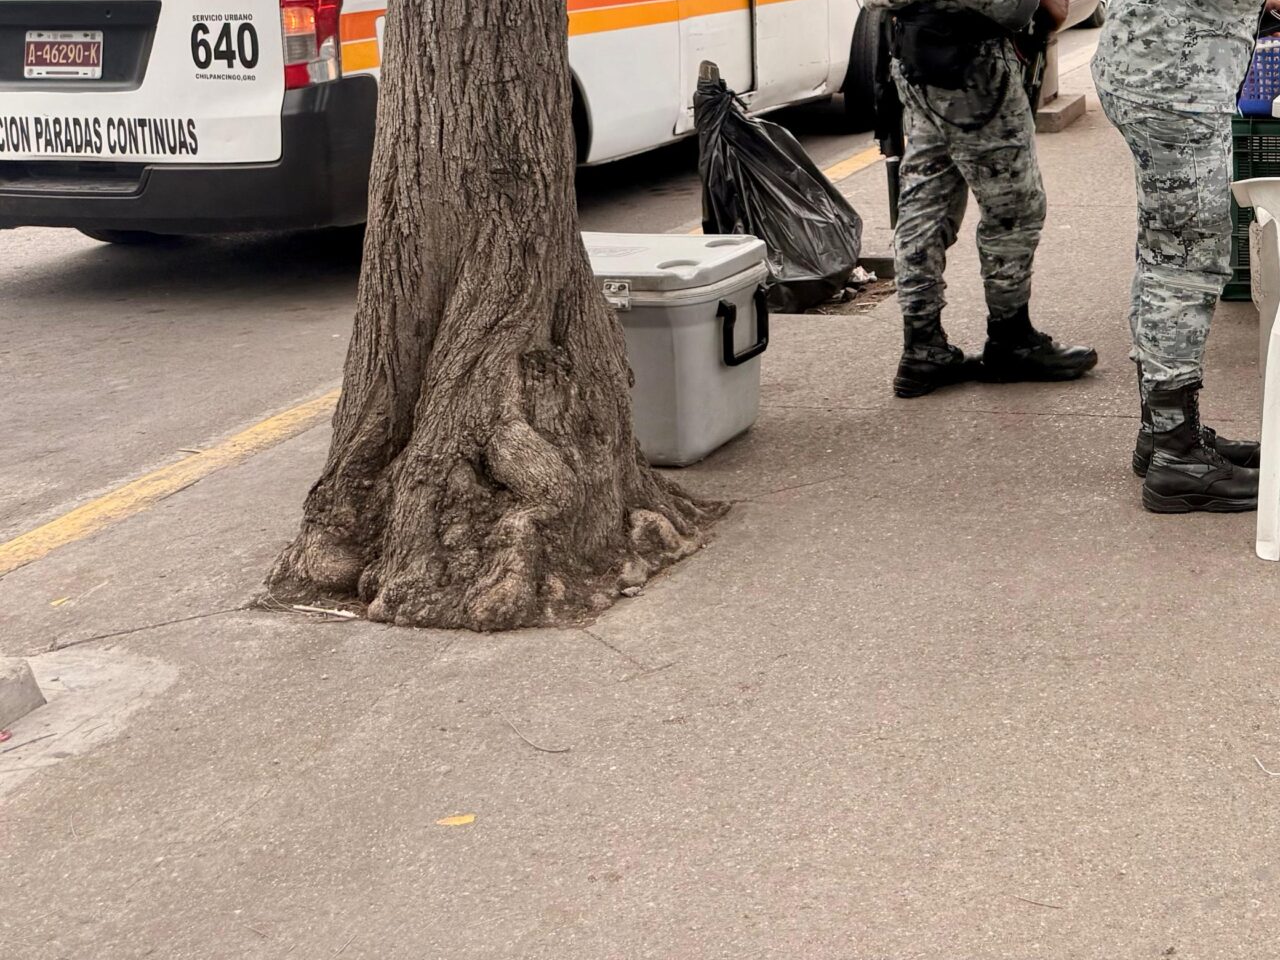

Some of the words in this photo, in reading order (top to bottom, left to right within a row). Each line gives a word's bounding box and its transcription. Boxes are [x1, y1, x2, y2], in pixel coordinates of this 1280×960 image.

[192, 14, 223, 22] SERVICIO
[224, 13, 253, 21] URBANO
[28, 43, 98, 64] A-46290-K
[191, 22, 259, 69] 640
[34, 117, 103, 154] PARADAS
[106, 117, 198, 155] CONTINUAS
